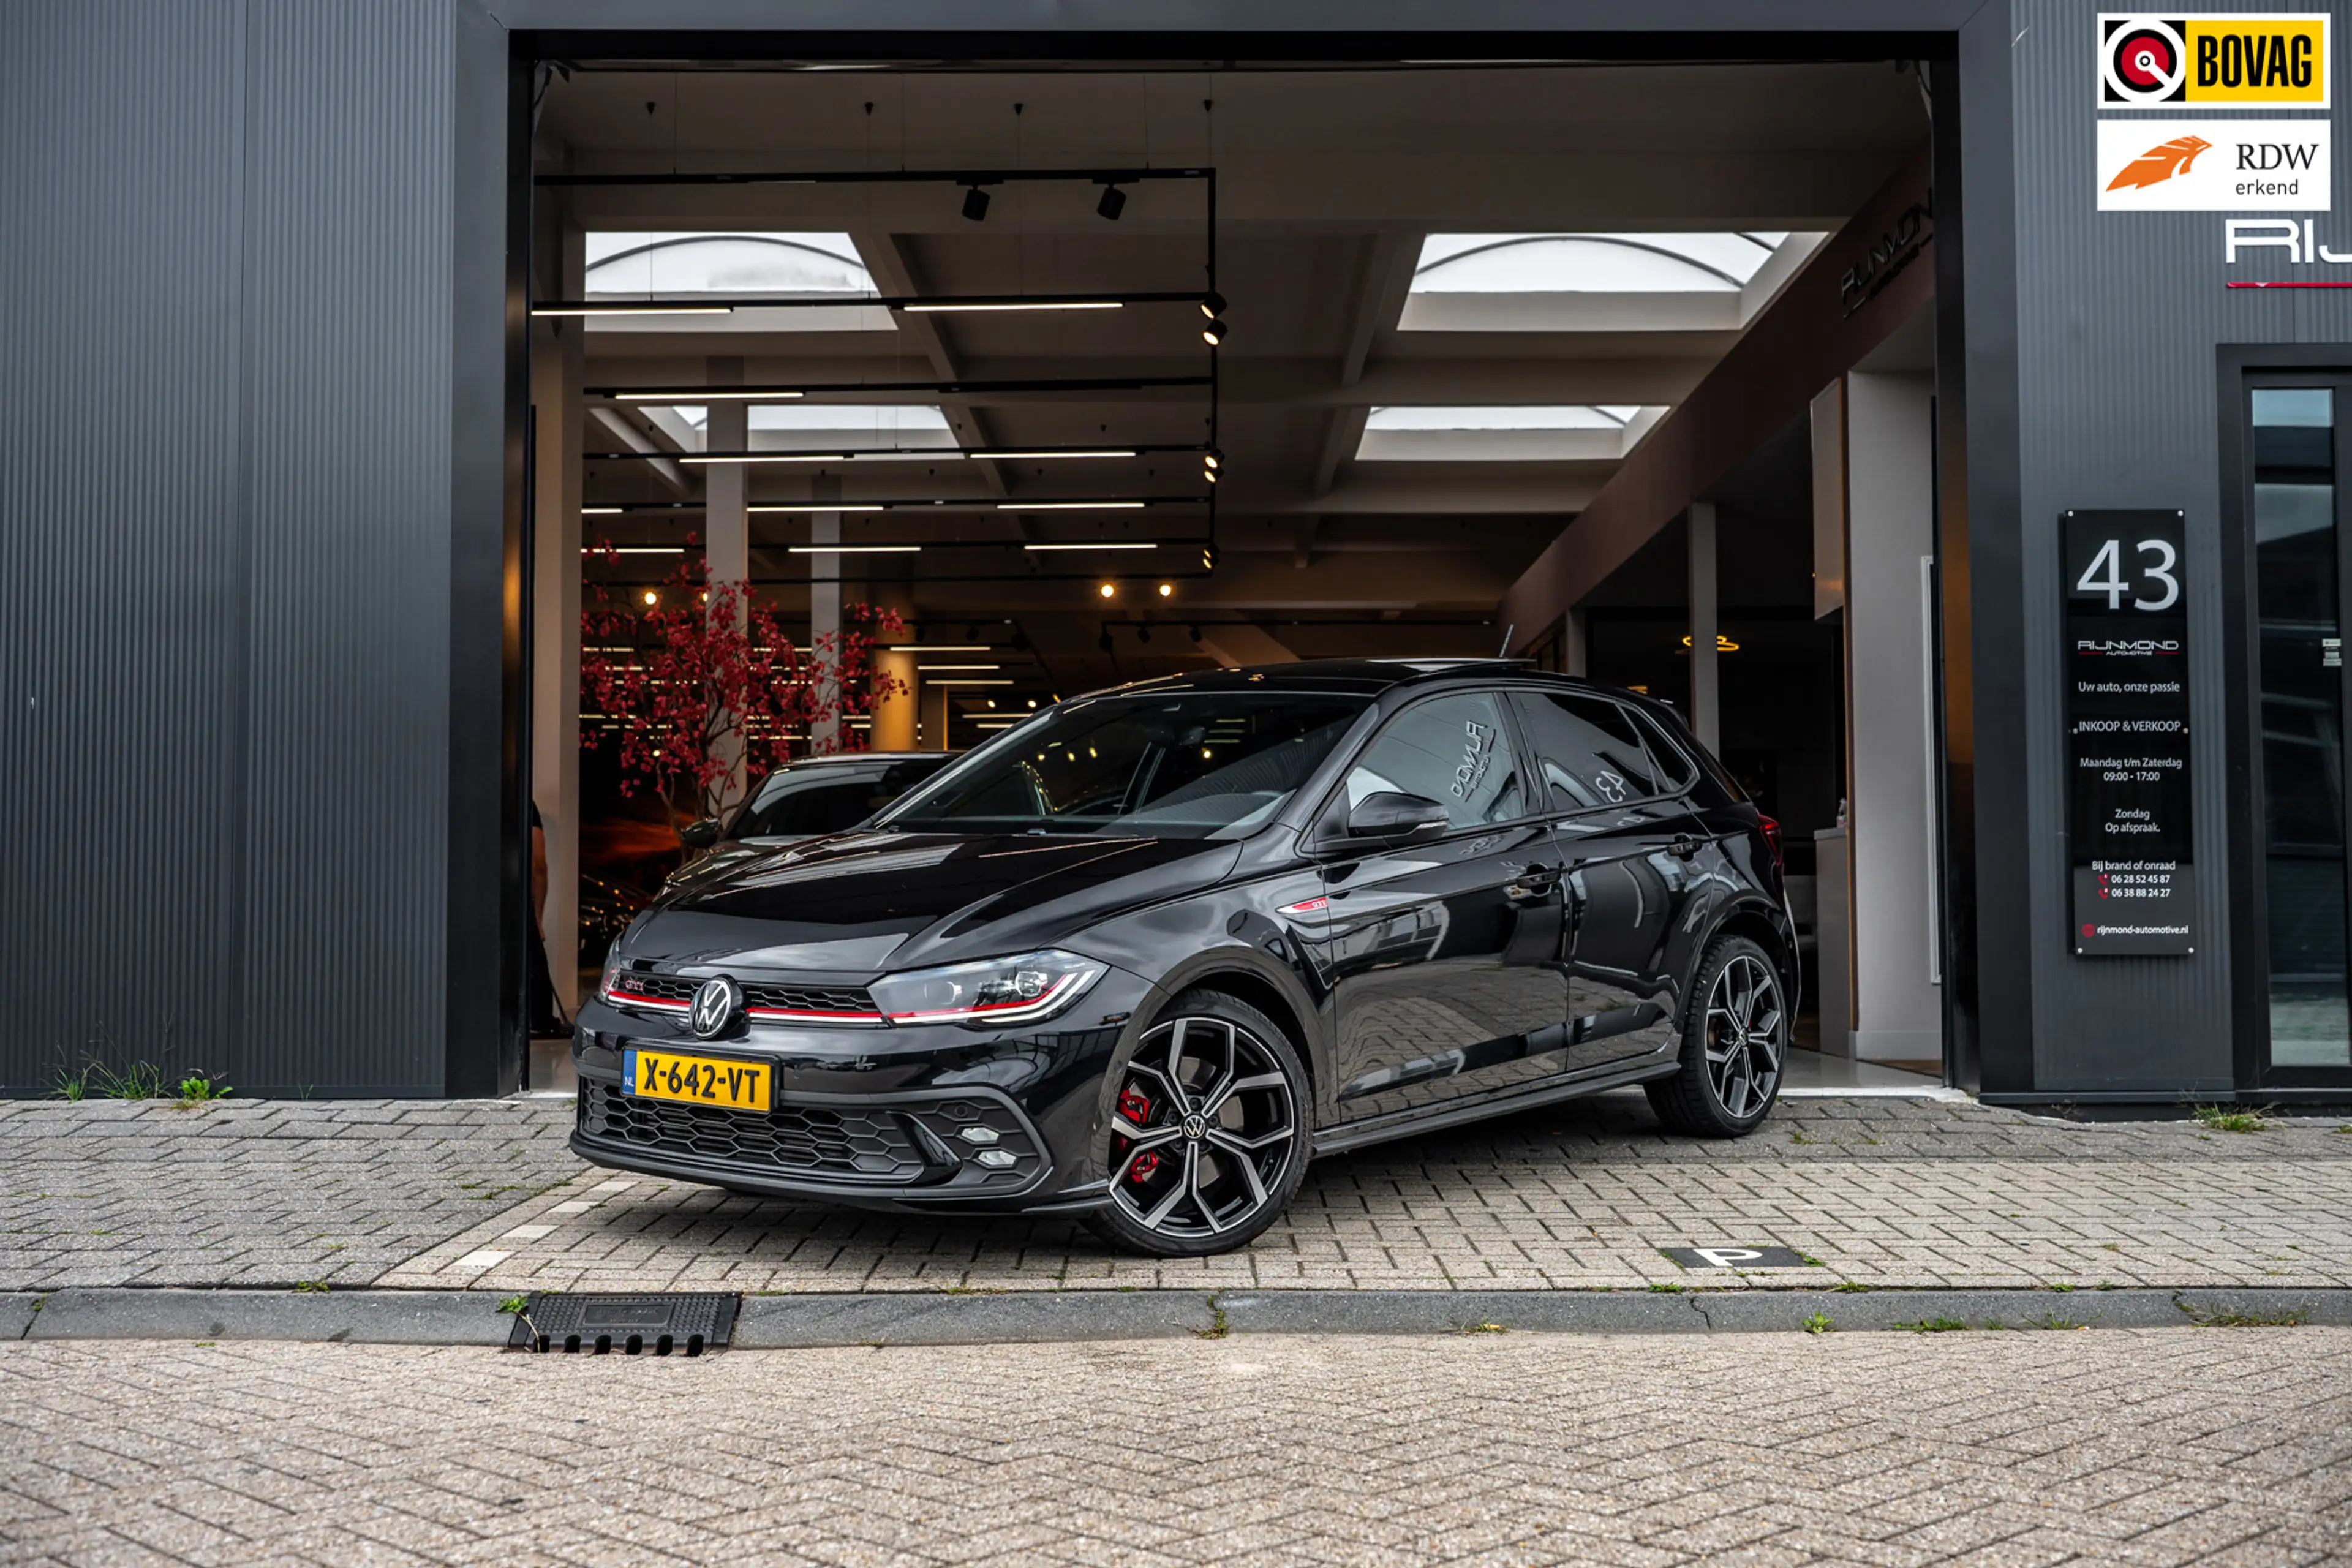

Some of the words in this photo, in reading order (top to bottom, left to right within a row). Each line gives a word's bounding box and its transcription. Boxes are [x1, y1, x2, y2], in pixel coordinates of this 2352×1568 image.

[2076, 539, 2179, 611] 43
[2078, 640, 2179, 650] RIJNMOND
[2078, 682, 2095, 692] Uw
[2097, 682, 2122, 693] auto,
[2124, 683, 2149, 692] onze
[2150, 681, 2180, 694] passie
[2079, 721, 2120, 732] INKOOP
[2122, 721, 2131, 732] &
[2132, 721, 2181, 732] VERKOOP
[2080, 757, 2122, 770] Maandag
[2124, 758, 2141, 767] t/m
[2143, 757, 2182, 770] Zaterdag
[2103, 771, 2128, 782] 09:00
[2136, 771, 2160, 782] 17:00
[2115, 809, 2150, 821] Zondag
[2105, 822, 2119, 834] Op
[2120, 822, 2161, 834] afspraak.
[2092, 861, 2103, 873] Bij
[2105, 861, 2132, 870] brand
[2133, 860, 2143, 870] of
[2144, 861, 2176, 870] onraad
[2111, 875, 2122, 884] 06
[2124, 875, 2135, 884] 28
[2136, 875, 2146, 884] 52
[2147, 875, 2158, 884] 45
[2160, 875, 2171, 884] 87
[2111, 888, 2123, 897] 06
[2124, 888, 2135, 897] 38
[2136, 888, 2147, 897] 88
[2148, 888, 2159, 897] 24
[2160, 888, 2171, 897] 27
[2097, 925, 2189, 936] rijnmond-automotive.nl
[624, 1076, 635, 1087] NL
[643, 1058, 760, 1103] X-642-VT
[1693, 1248, 1763, 1267] P
